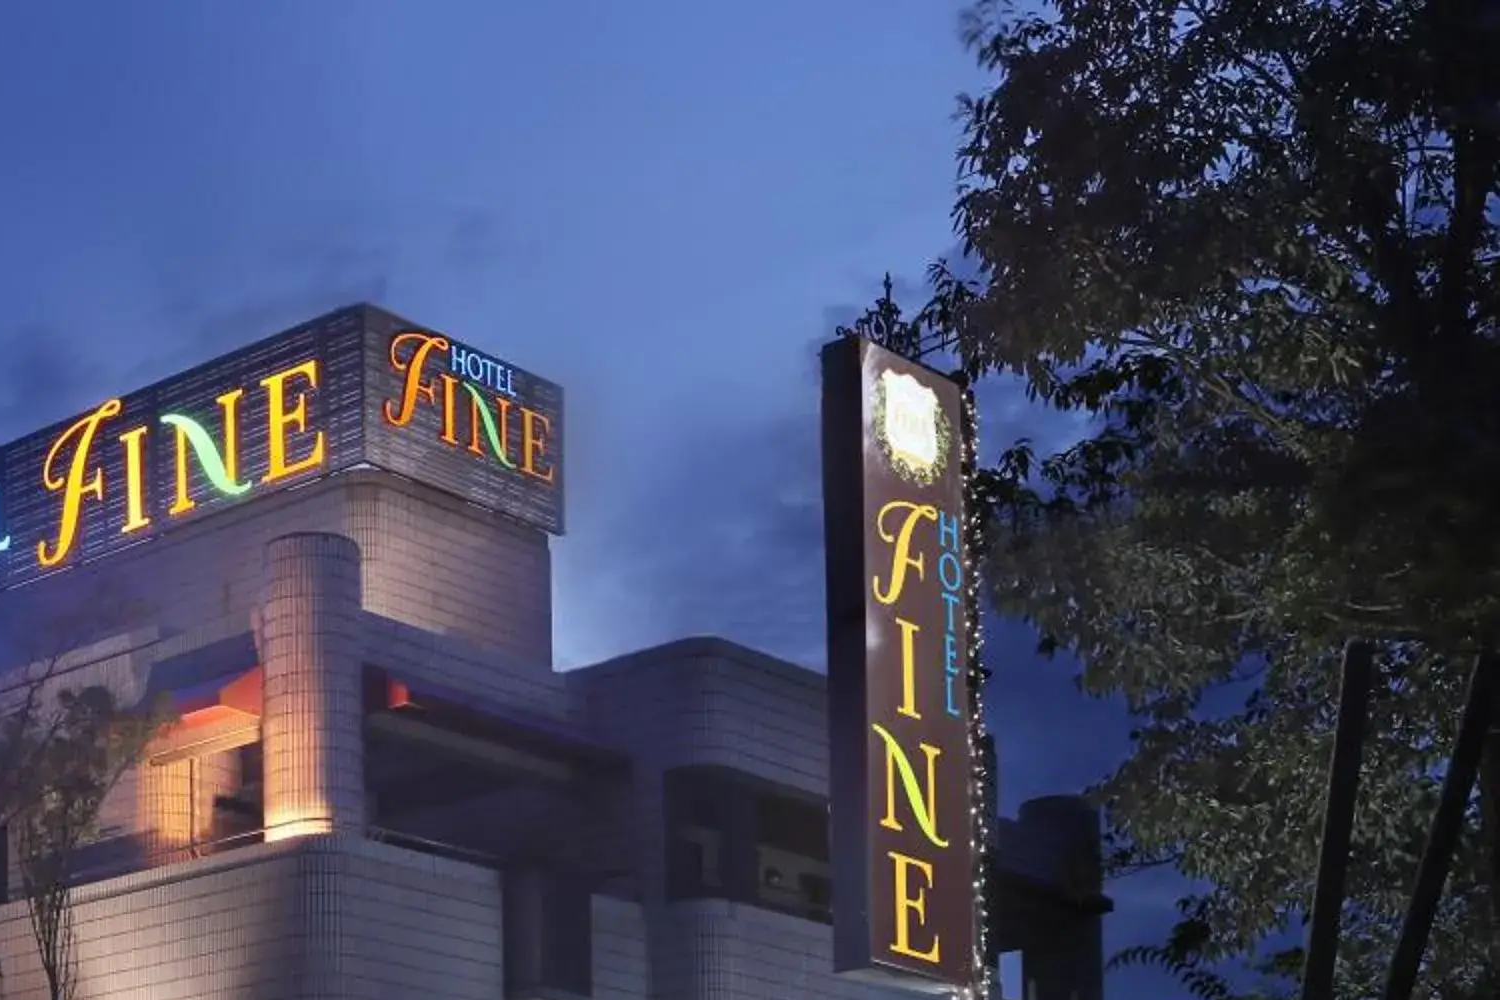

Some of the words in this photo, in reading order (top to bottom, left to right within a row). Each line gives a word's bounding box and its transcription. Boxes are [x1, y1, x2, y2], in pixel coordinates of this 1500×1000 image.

[37, 359, 327, 567] FINE
[384, 332, 555, 483] FINE
[451, 345, 518, 397] HOTEL
[939, 512, 962, 717] HOTEL
[873, 500, 949, 964] FINE
